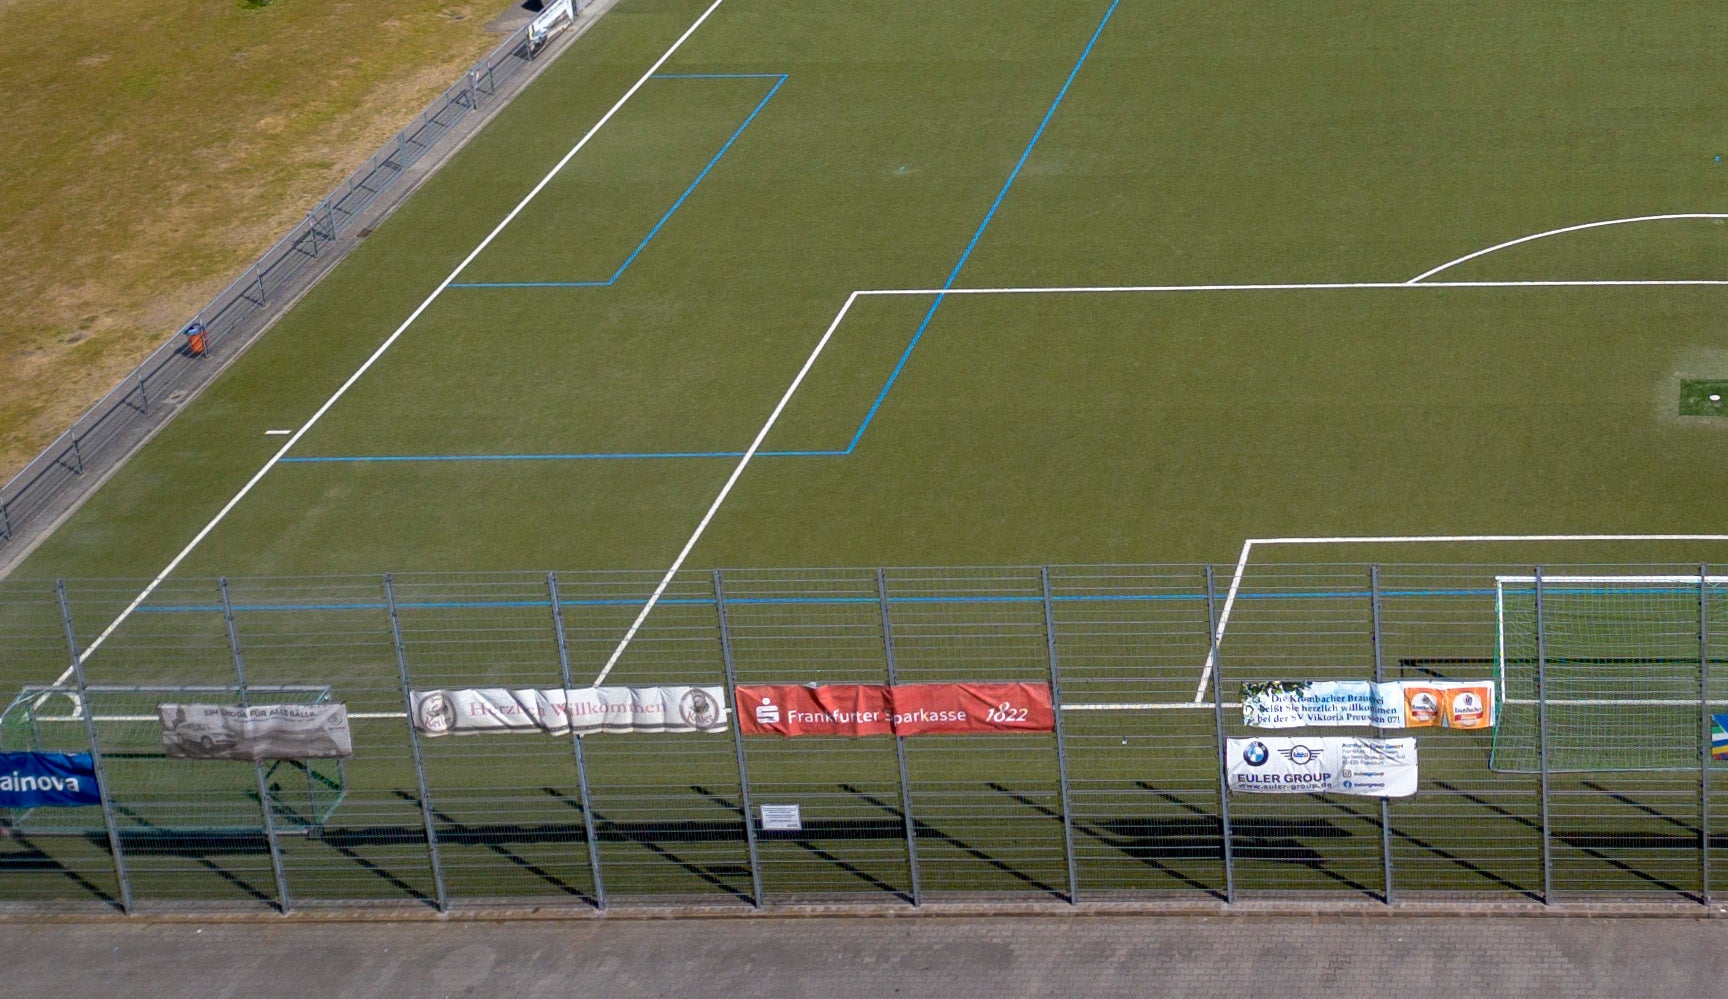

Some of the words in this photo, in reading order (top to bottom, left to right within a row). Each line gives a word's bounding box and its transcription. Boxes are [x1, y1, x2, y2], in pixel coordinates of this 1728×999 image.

[1290, 694, 1346, 703] Krombacher
[470, 701, 546, 718] Herzlich
[550, 700, 668, 718] Willkommen
[787, 708, 879, 725] Frankfurter
[884, 707, 967, 727] Sparkasse
[985, 701, 1029, 723] 1822
[1301, 703, 1339, 713] herzlich
[1273, 713, 1289, 723] der
[1306, 713, 1344, 723] Viktoria
[0, 771, 80, 793] ainova
[1237, 773, 1281, 784] EULER
[1283, 772, 1332, 784] GROUP
